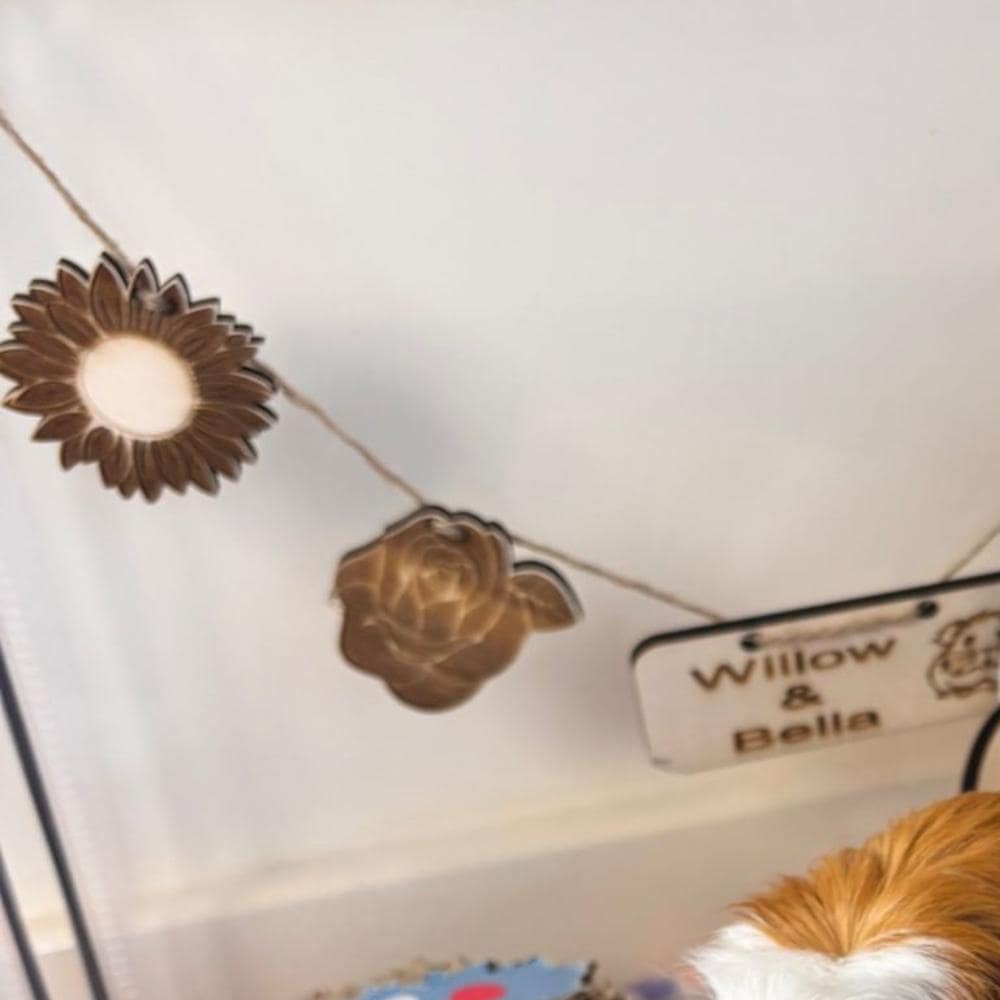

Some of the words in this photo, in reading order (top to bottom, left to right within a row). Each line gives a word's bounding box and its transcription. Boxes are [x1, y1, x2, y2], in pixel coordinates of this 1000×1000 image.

[691, 639, 897, 690] Willow
[782, 684, 822, 710] &
[733, 710, 880, 754] Bella
